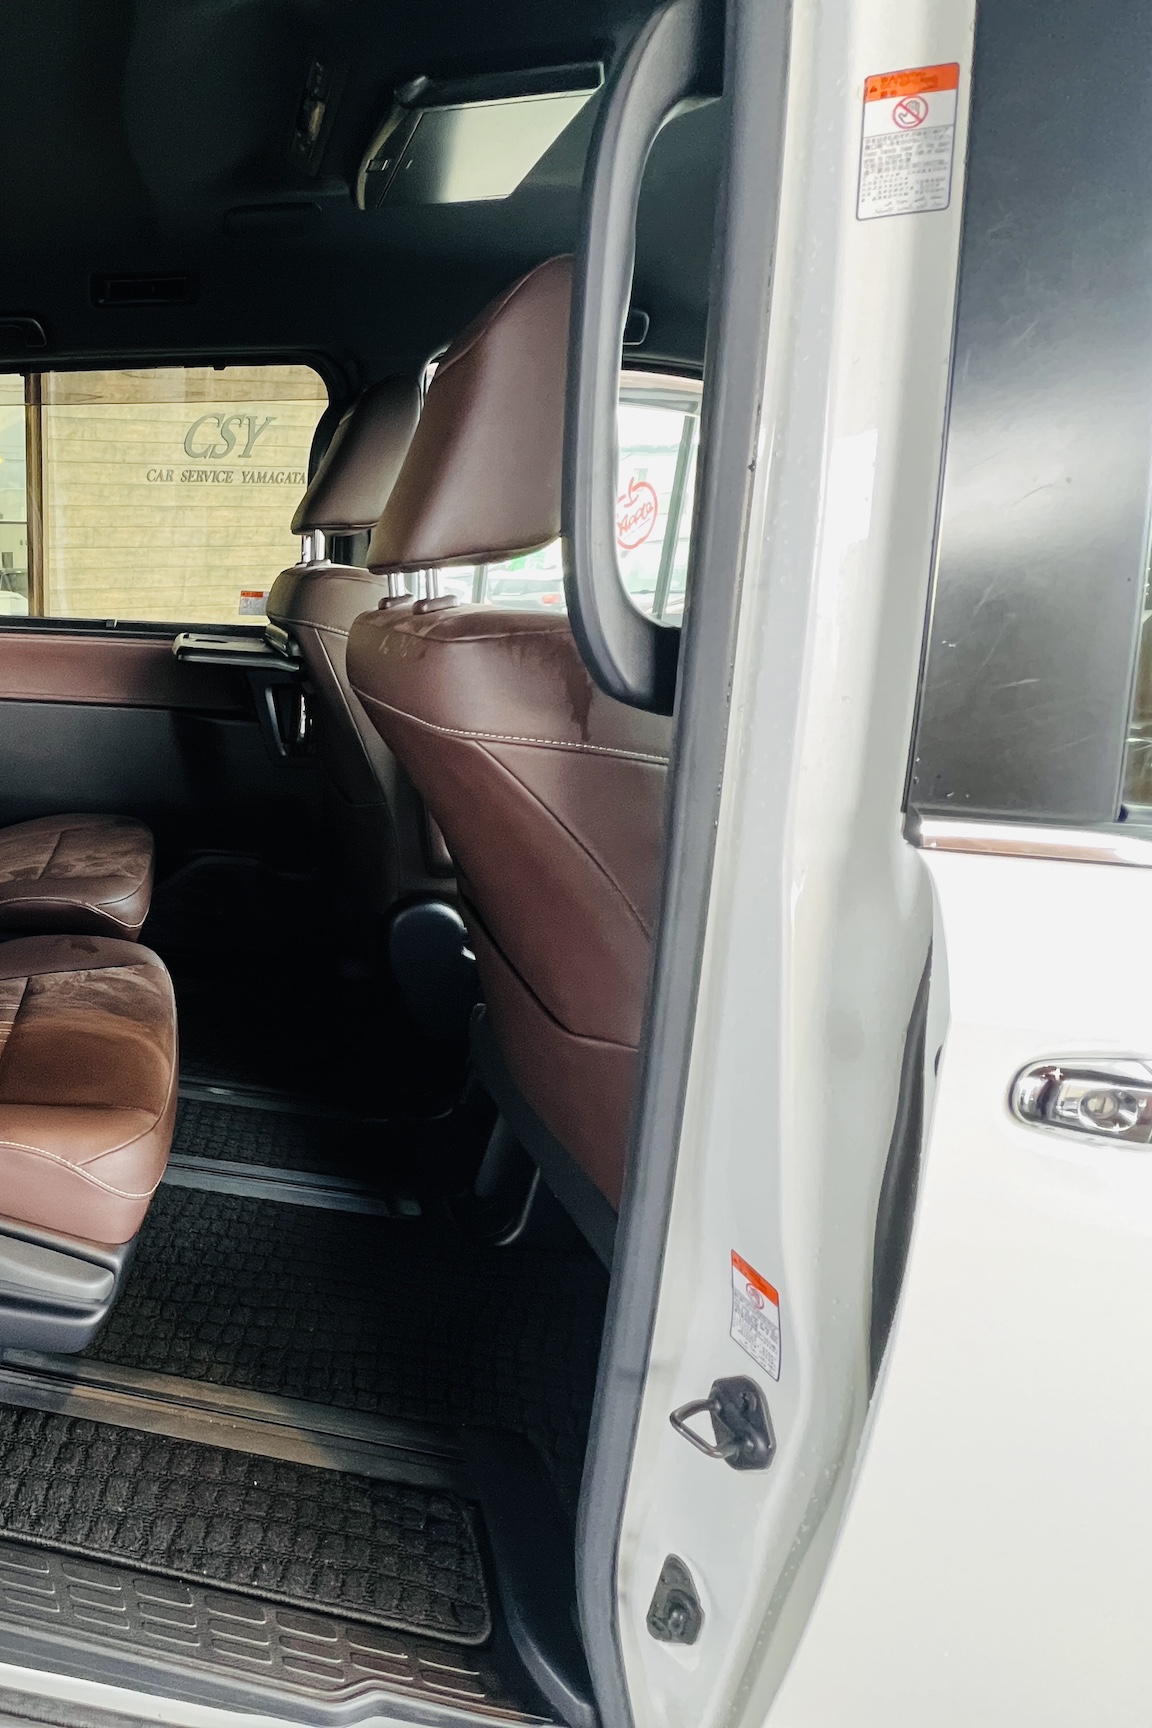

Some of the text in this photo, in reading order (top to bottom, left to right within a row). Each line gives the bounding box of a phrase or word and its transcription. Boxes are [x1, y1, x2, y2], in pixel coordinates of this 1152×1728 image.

[184, 412, 276, 459] CSY
[146, 468, 306, 485] CAR SERVICE YAMAGATA
